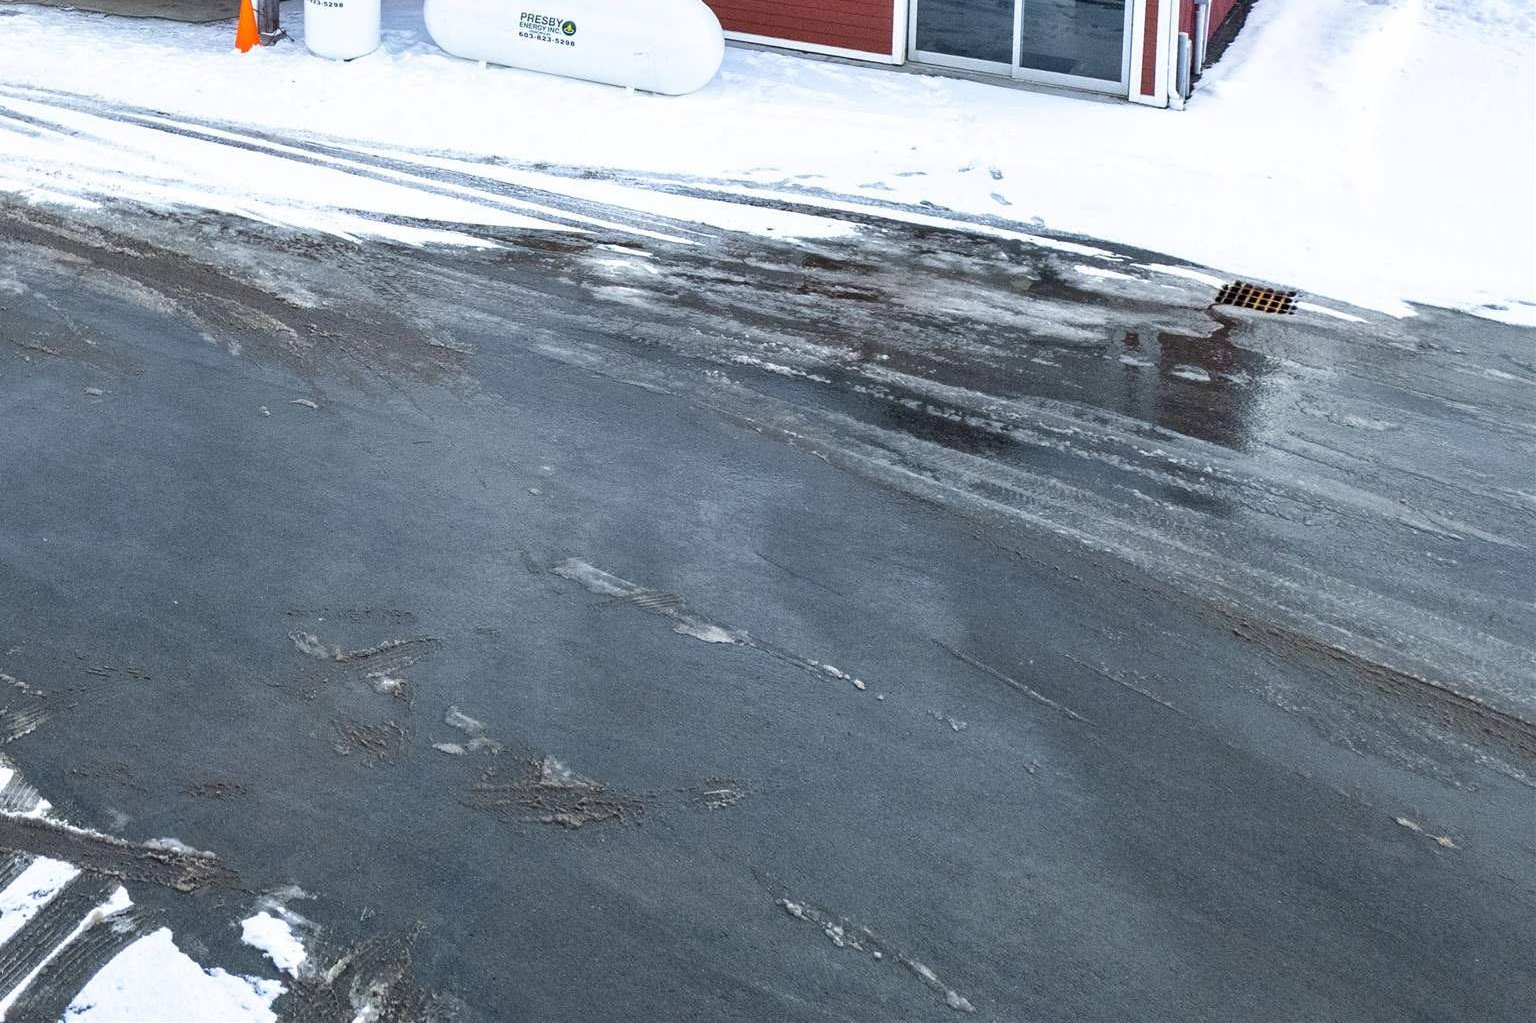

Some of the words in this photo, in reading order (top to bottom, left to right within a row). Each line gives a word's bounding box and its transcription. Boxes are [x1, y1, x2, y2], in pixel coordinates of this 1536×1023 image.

[520, 12, 564, 27] PRESBY
[519, 21, 547, 31] ENERGY
[547, 27, 562, 35] INC.
[519, 31, 575, 47] 603-823-5298
